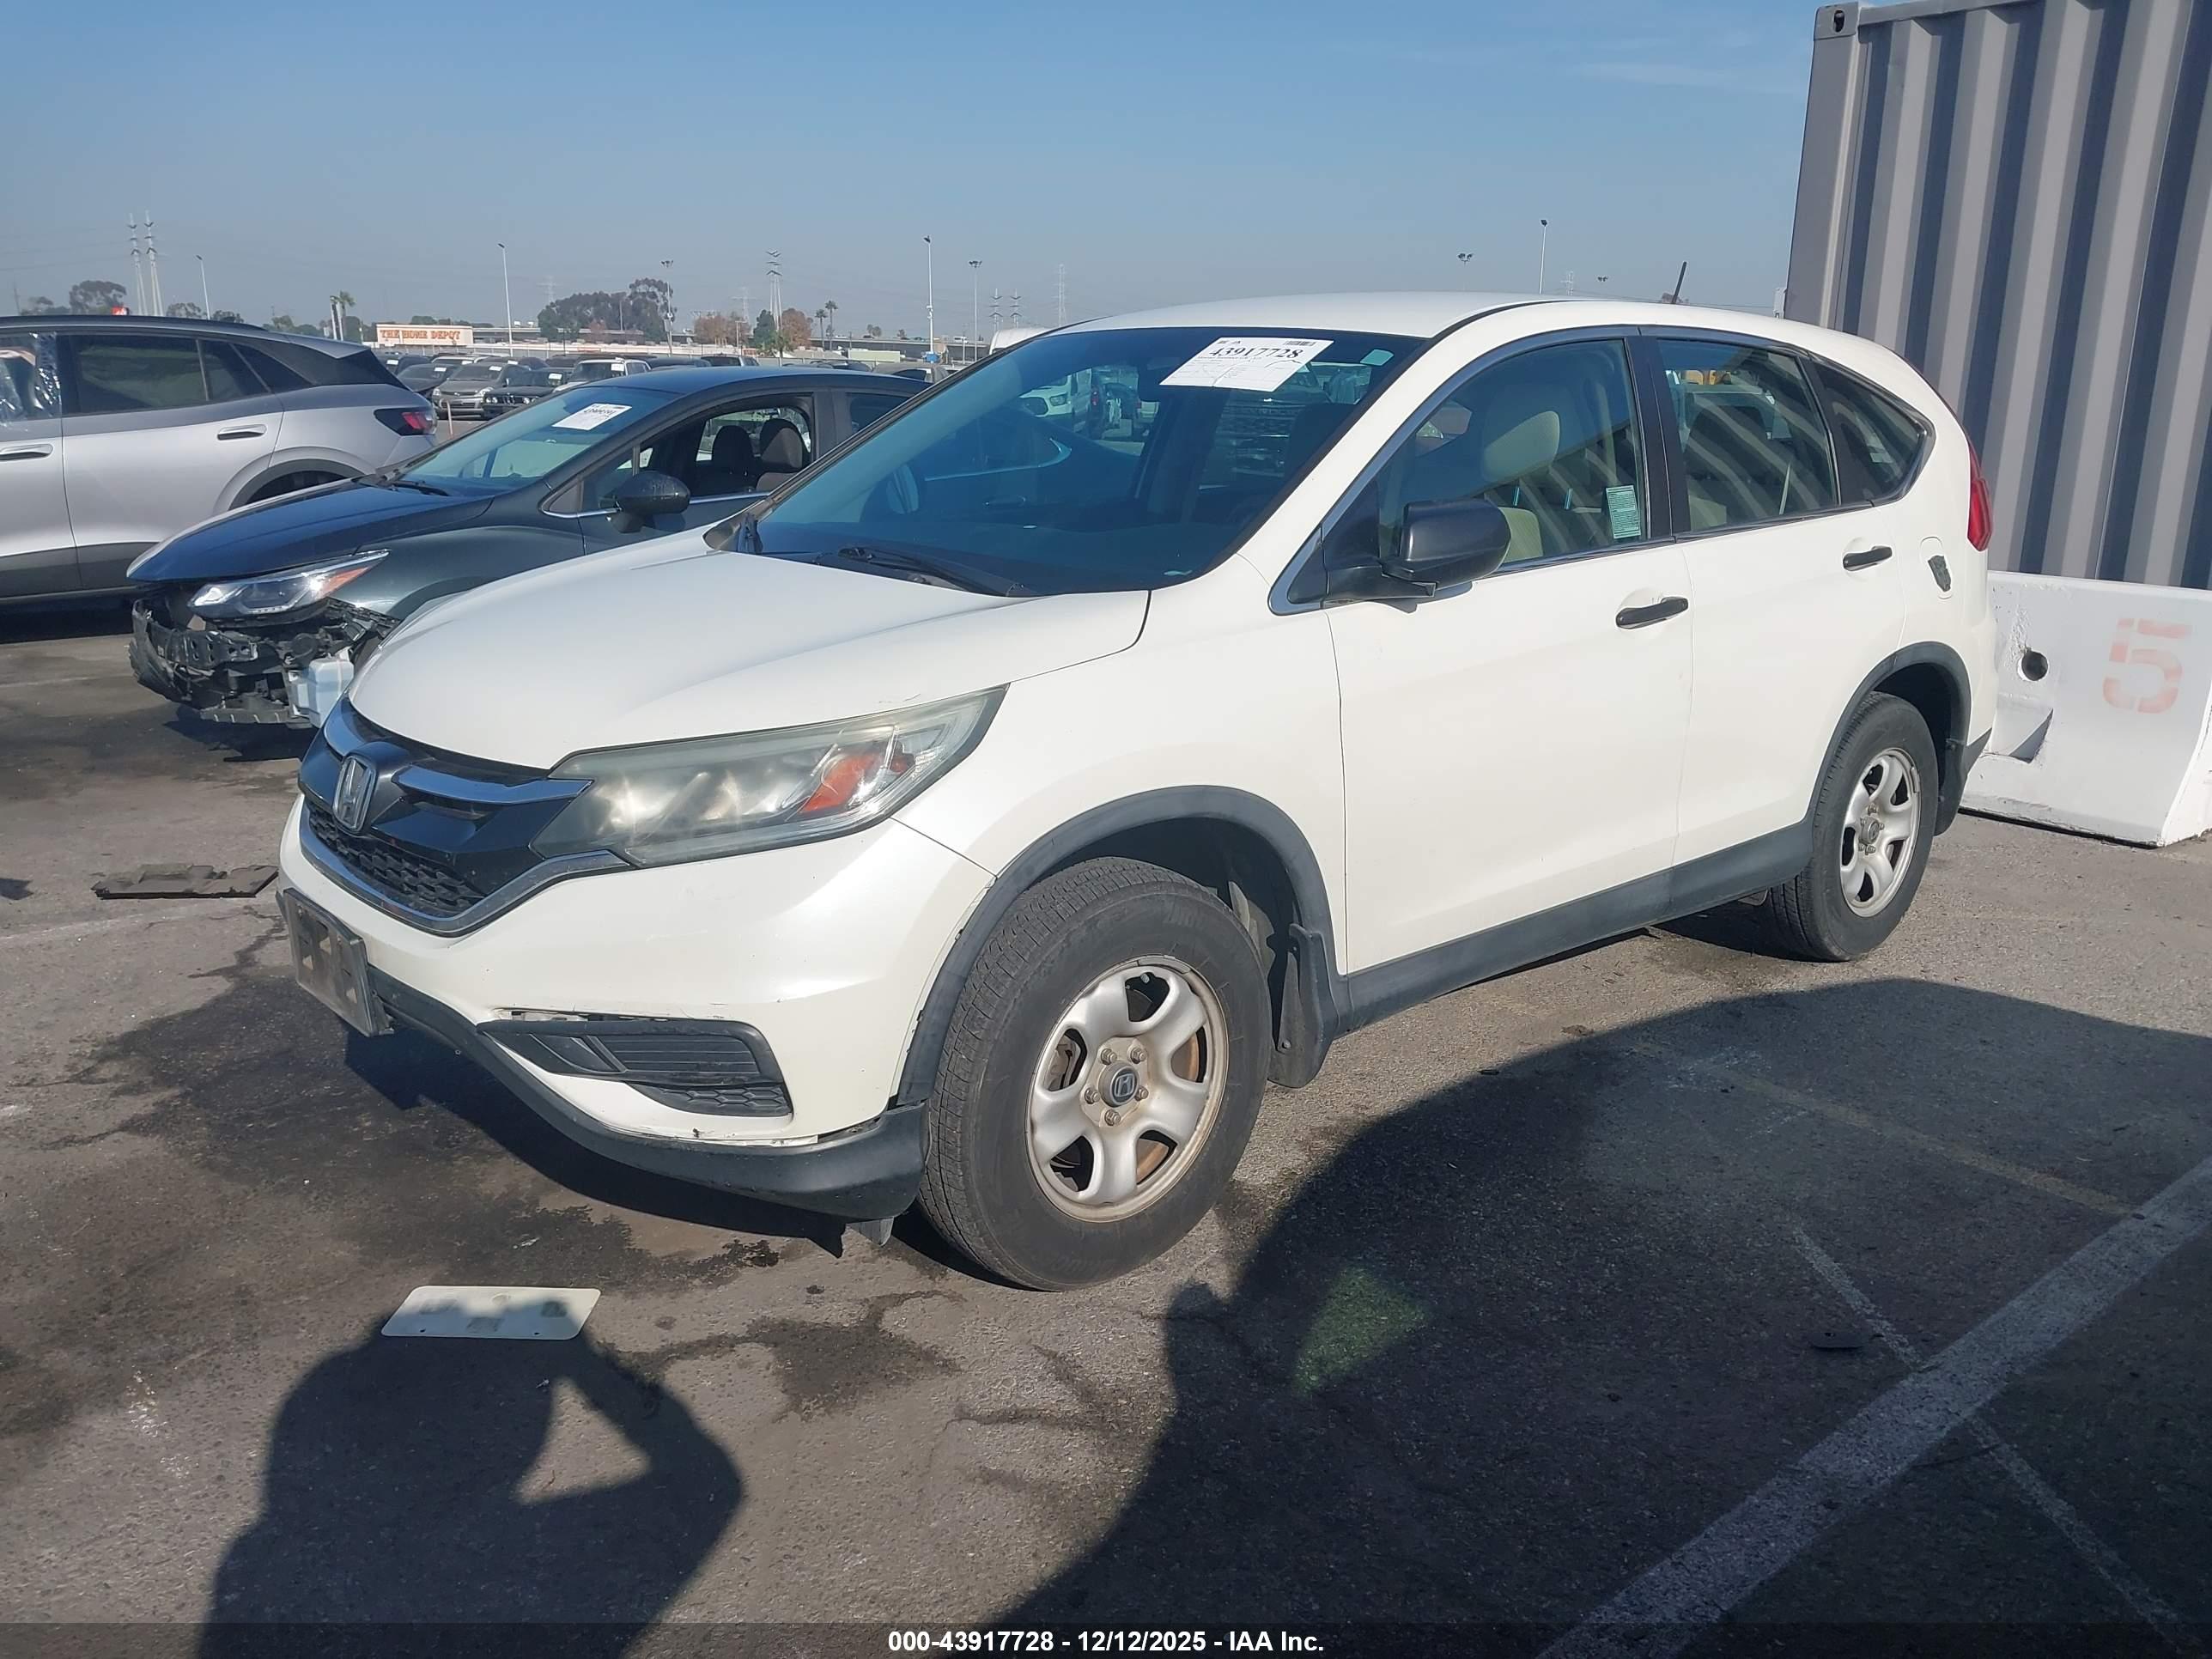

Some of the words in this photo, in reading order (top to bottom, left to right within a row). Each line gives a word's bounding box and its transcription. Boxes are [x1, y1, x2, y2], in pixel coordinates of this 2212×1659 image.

[380, 330, 400, 338] THE
[402, 330, 428, 338] HOME
[430, 331, 460, 340] DEPOT
[1209, 346, 1304, 359] 43917728
[2102, 617, 2192, 714] 5
